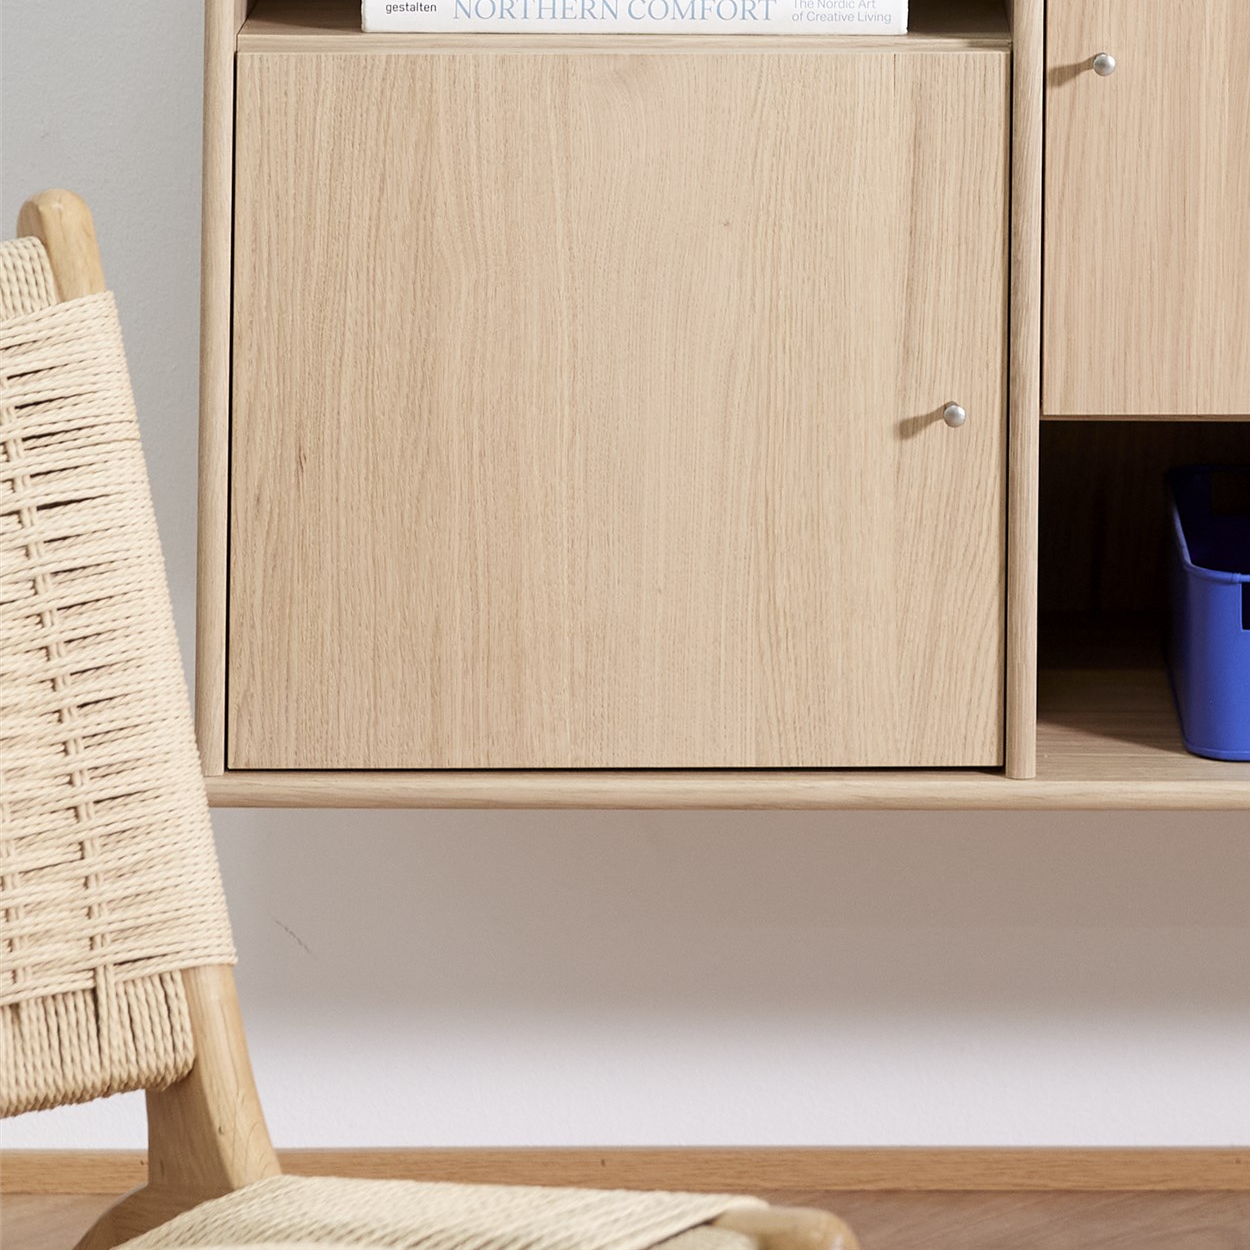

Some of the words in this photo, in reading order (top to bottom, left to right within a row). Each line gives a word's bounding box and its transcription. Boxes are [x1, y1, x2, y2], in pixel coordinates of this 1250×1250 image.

[386, 3, 436, 14] gestalten
[858, 0, 875, 9] Art
[792, 11, 803, 22] of
[807, 11, 854, 22] Creative
[858, 11, 892, 24] Living
